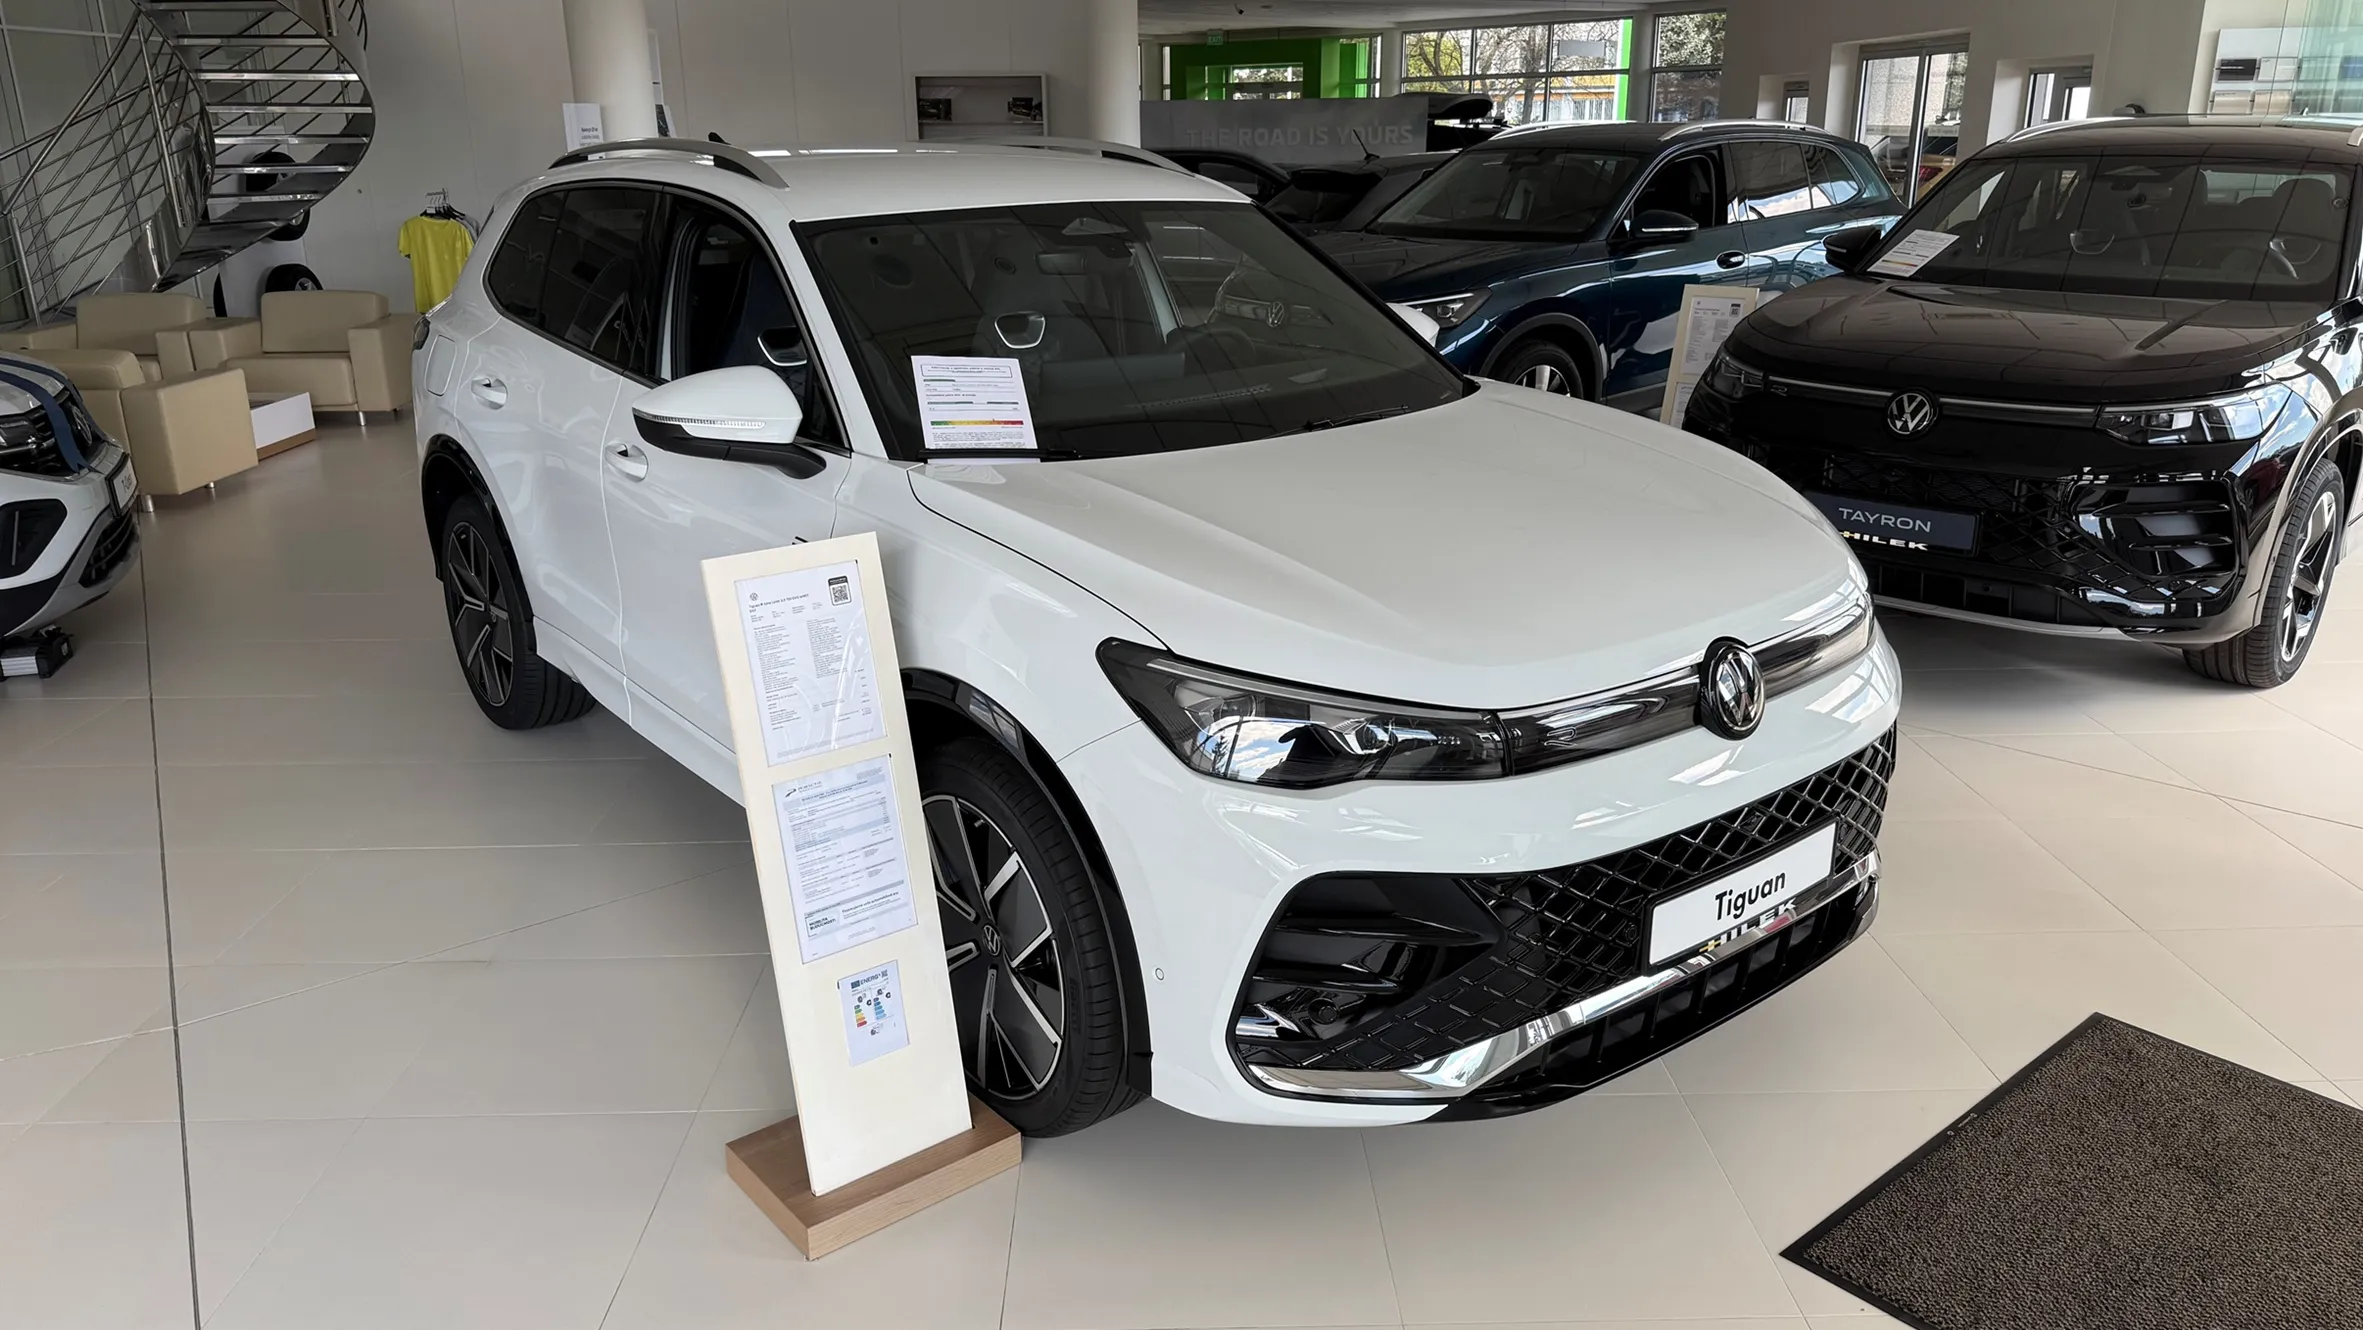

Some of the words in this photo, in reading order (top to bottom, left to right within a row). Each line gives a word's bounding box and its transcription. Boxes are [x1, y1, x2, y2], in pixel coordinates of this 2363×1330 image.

[1185, 128, 1231, 147] THE
[1237, 127, 1301, 147] ROAD
[1308, 126, 1329, 146] IS
[1336, 125, 1414, 145] YOURS
[1838, 507, 1932, 533] TAYRON
[1841, 530, 1928, 551] HILEK
[1715, 872, 1786, 921] Tiguan
[1701, 897, 1797, 953] HILEK
